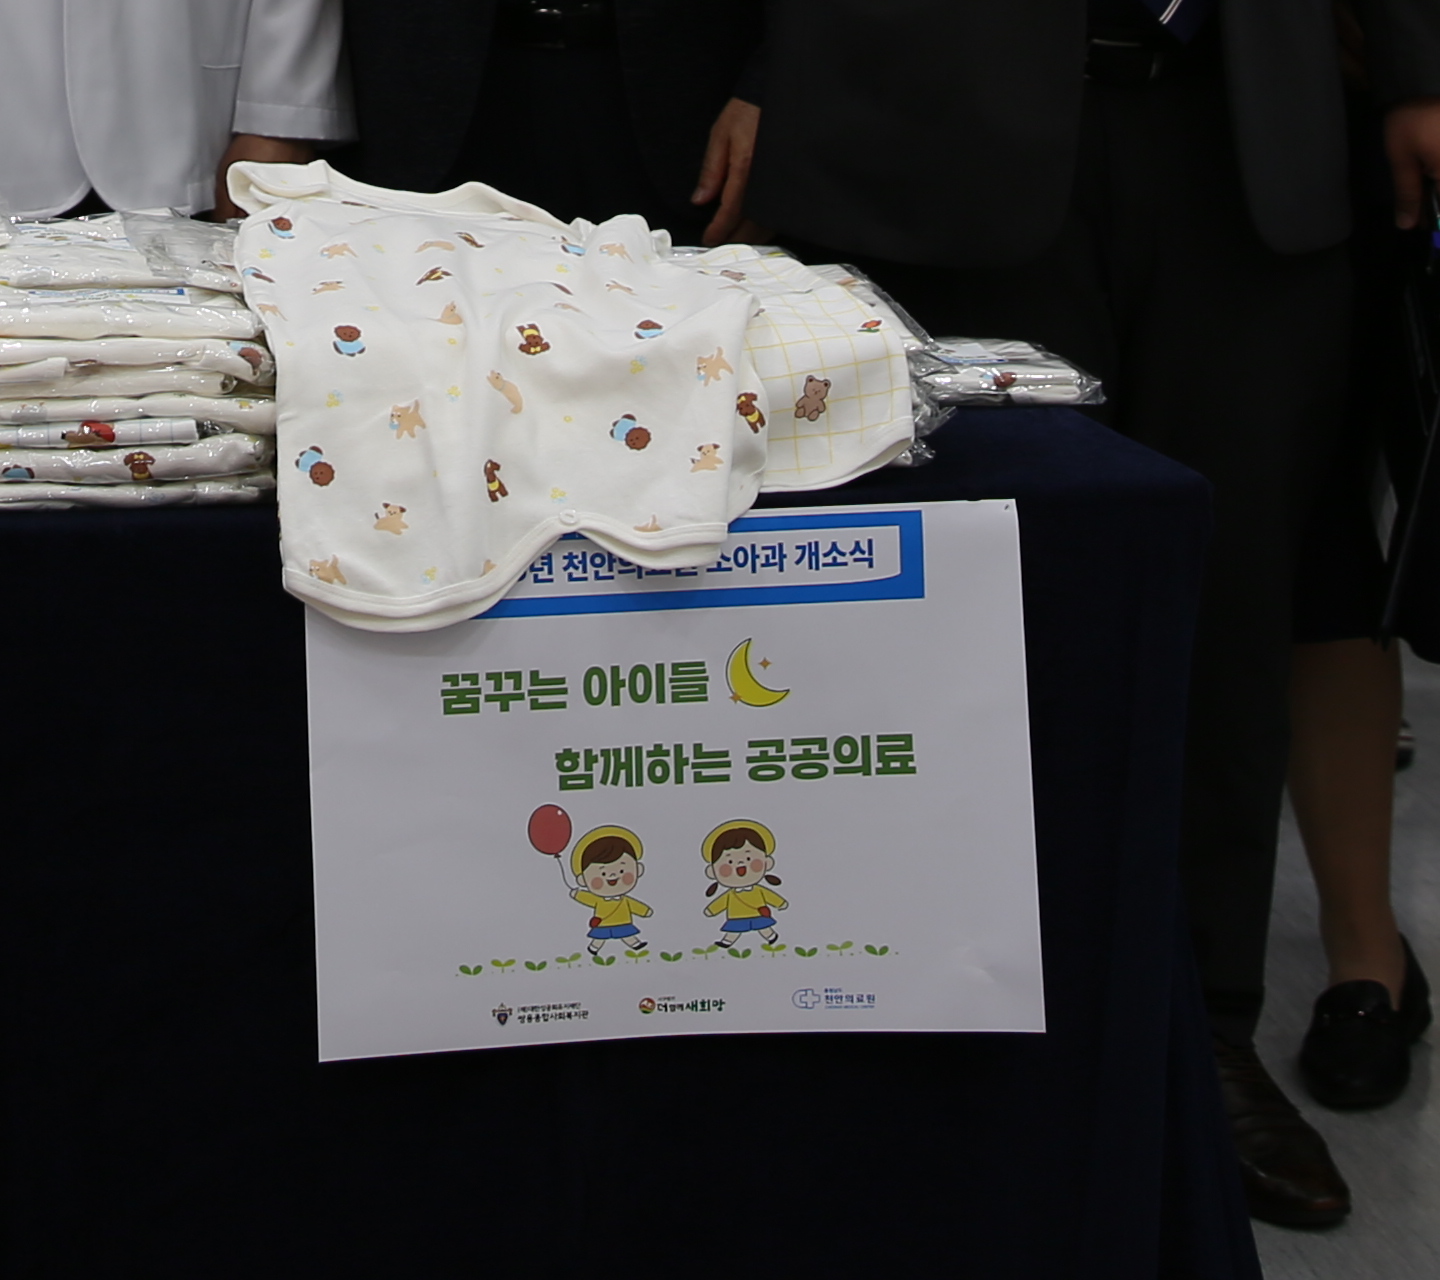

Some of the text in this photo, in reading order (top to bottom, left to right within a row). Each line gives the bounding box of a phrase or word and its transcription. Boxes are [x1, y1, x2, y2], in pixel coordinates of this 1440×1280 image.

[795, 538, 874, 571] 개소식
[440, 661, 710, 716] 꿈꾸는 아이들
[554, 733, 917, 791] 함께하는 공공의료
[824, 993, 876, 1005] 천안의료원
